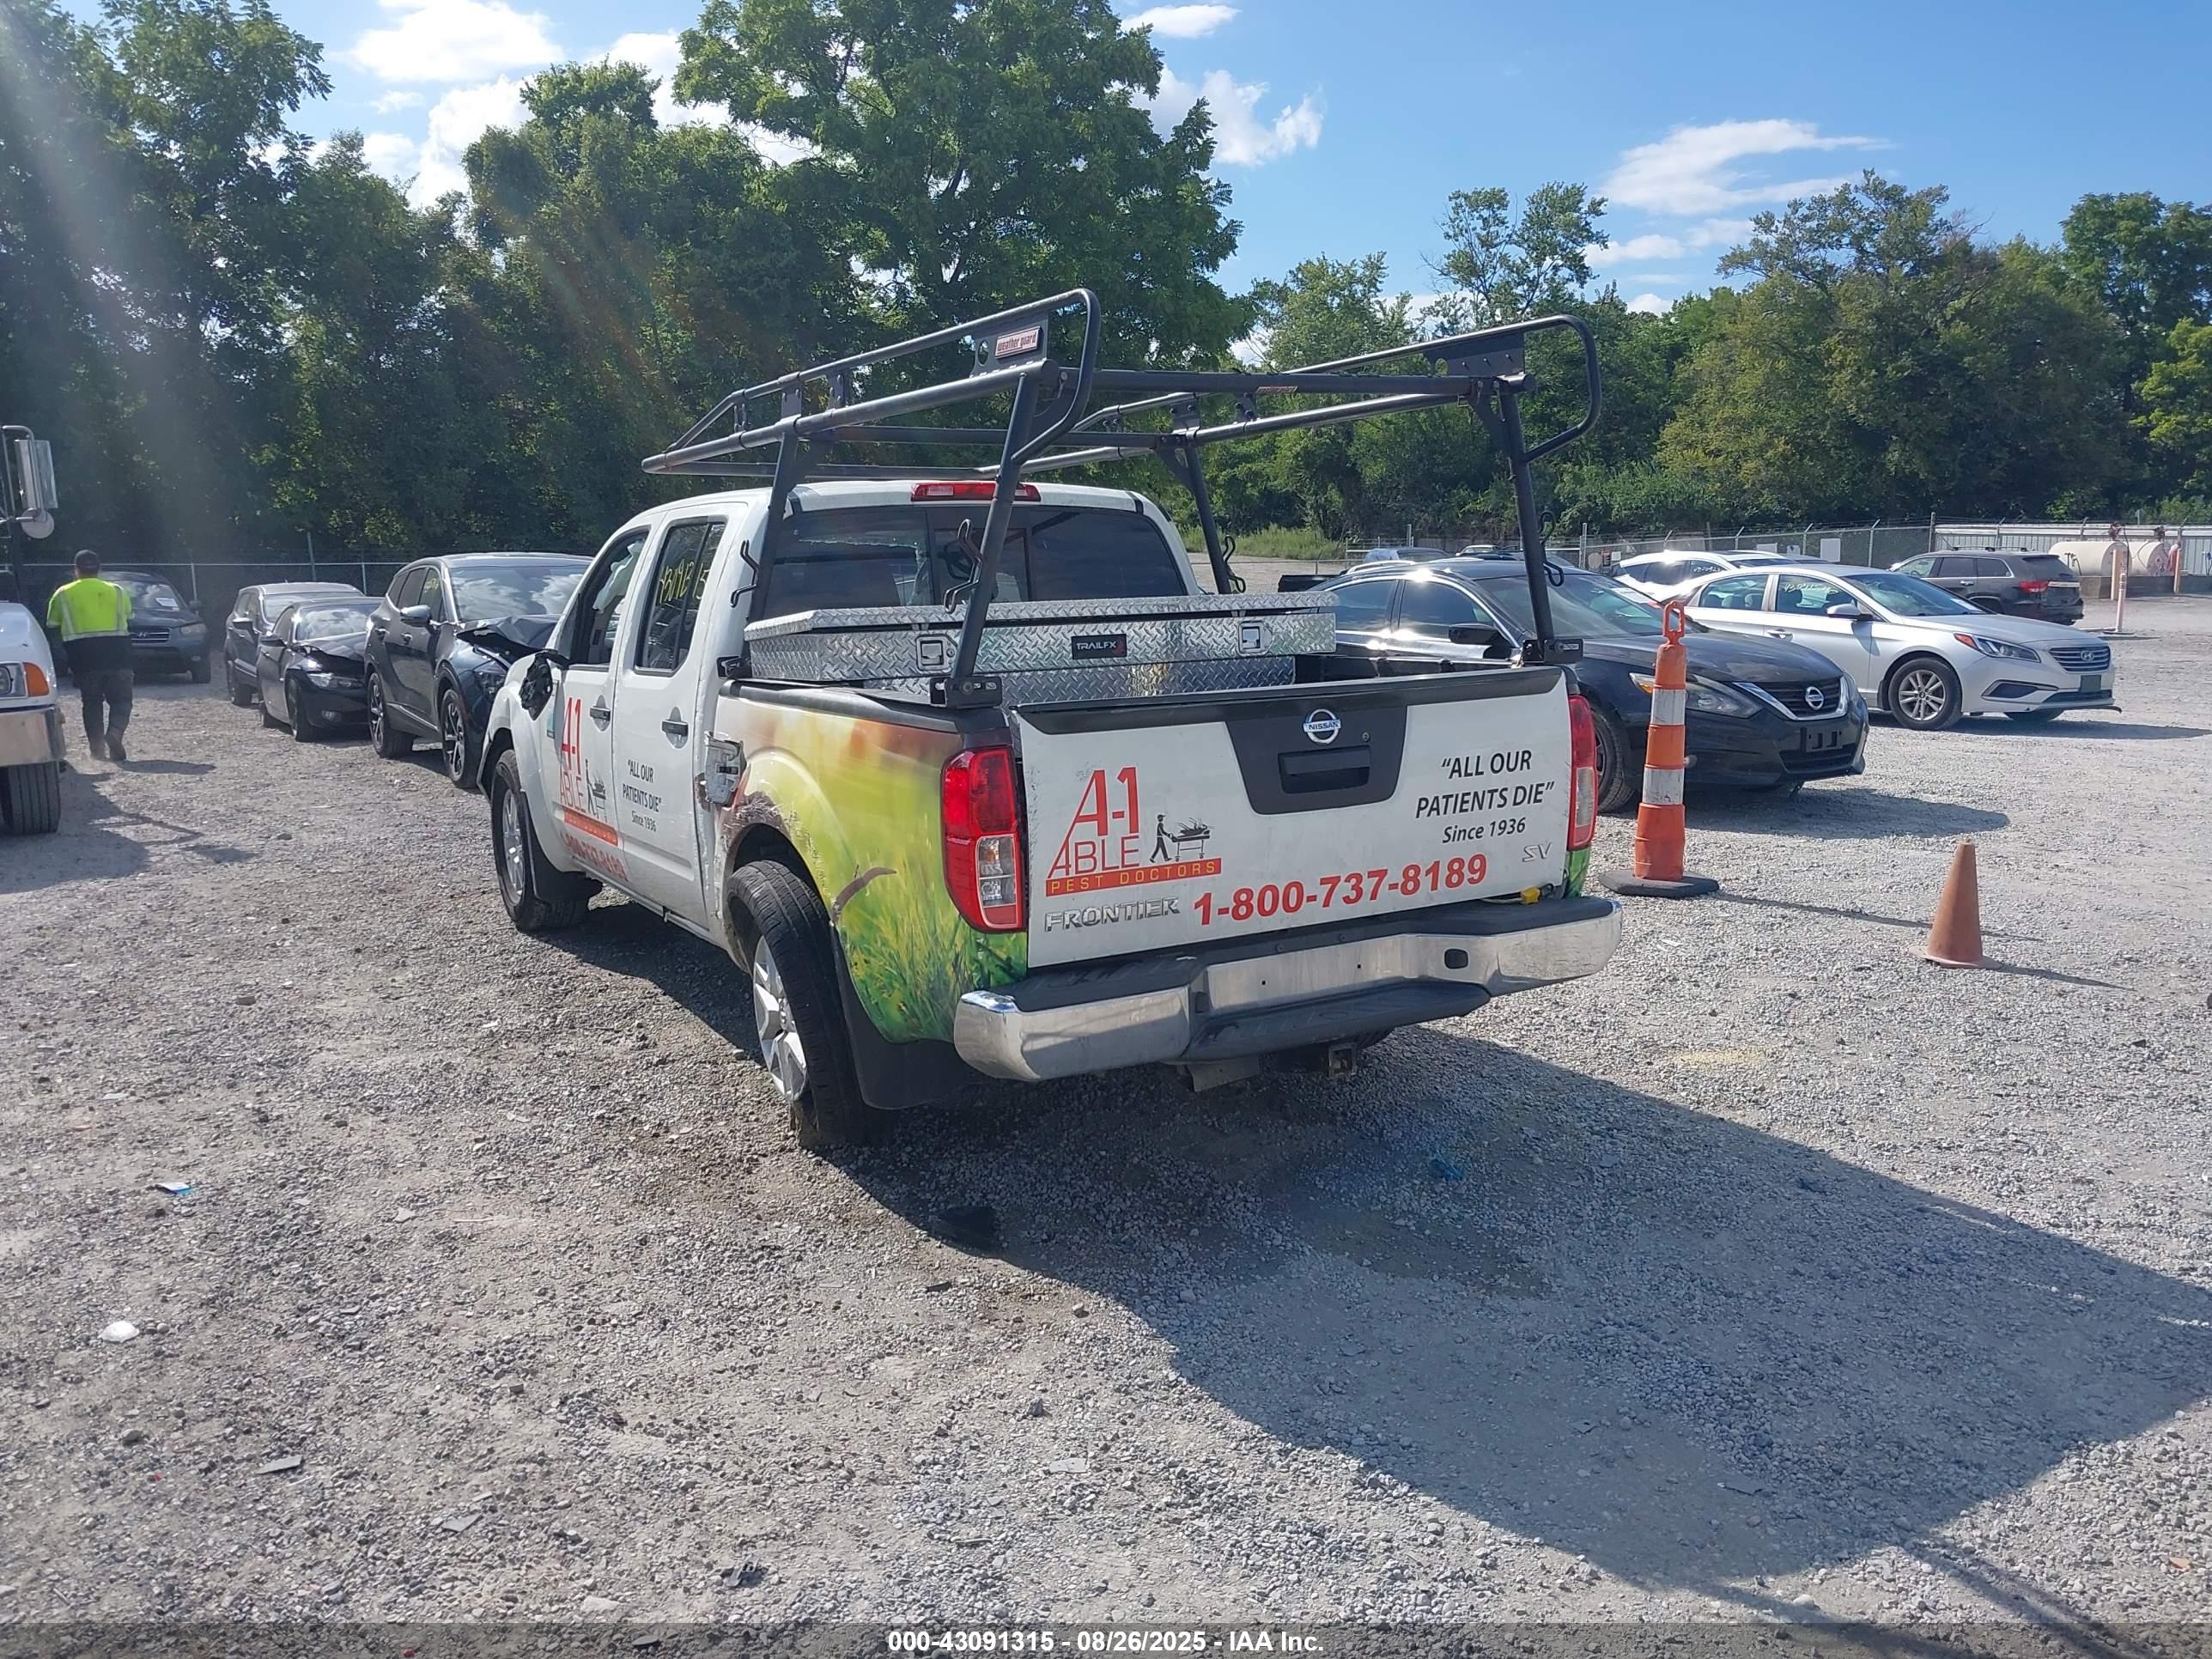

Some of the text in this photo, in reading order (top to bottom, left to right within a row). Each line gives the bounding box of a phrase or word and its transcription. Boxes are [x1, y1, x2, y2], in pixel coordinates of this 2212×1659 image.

[998, 331, 1036, 351] weather guard
[1076, 641, 1116, 651] TRAILFX
[1308, 721, 1339, 730] NISSAN
[641, 764, 653, 783] OUR
[1490, 750, 1533, 775] OUR
[623, 783, 648, 808] PATIENTS
[1069, 766, 1139, 836] A-1
[1415, 787, 1509, 819] PATIENTS
[1442, 817, 1526, 844] Since 1936
[1047, 834, 1140, 878] ABLE
[1522, 842, 1553, 862] SV
[1050, 860, 1216, 894] PEST DOCTORS
[1193, 853, 1488, 927] 1-800-737-8189
[1043, 896, 1181, 933] FRONTIER
